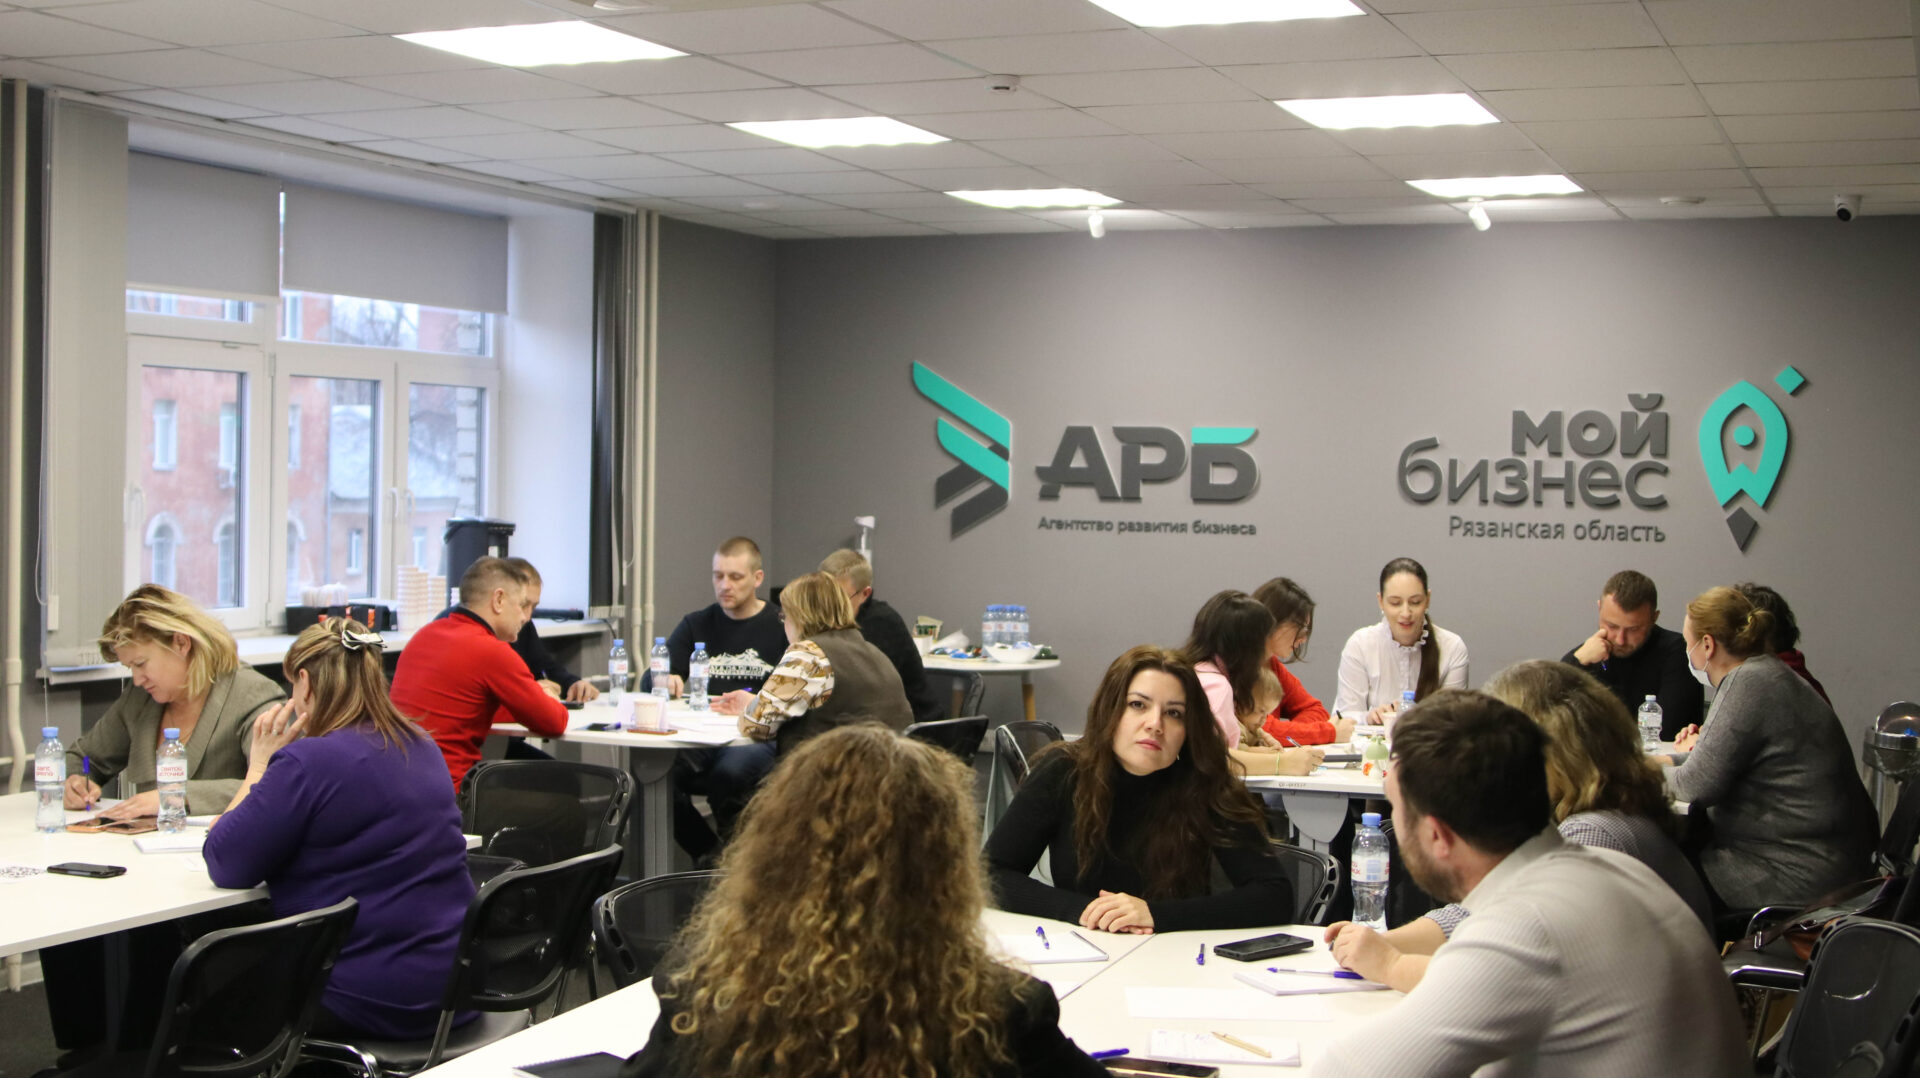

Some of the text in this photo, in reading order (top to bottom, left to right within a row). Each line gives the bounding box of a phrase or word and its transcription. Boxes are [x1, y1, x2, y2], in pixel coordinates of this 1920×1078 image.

[1035, 425, 1261, 504] АРБ
[1398, 436, 1670, 511] бизнес
[1038, 517, 1257, 535] Агентство развития бизнеса
[1449, 516, 1666, 543] Рязанская область
